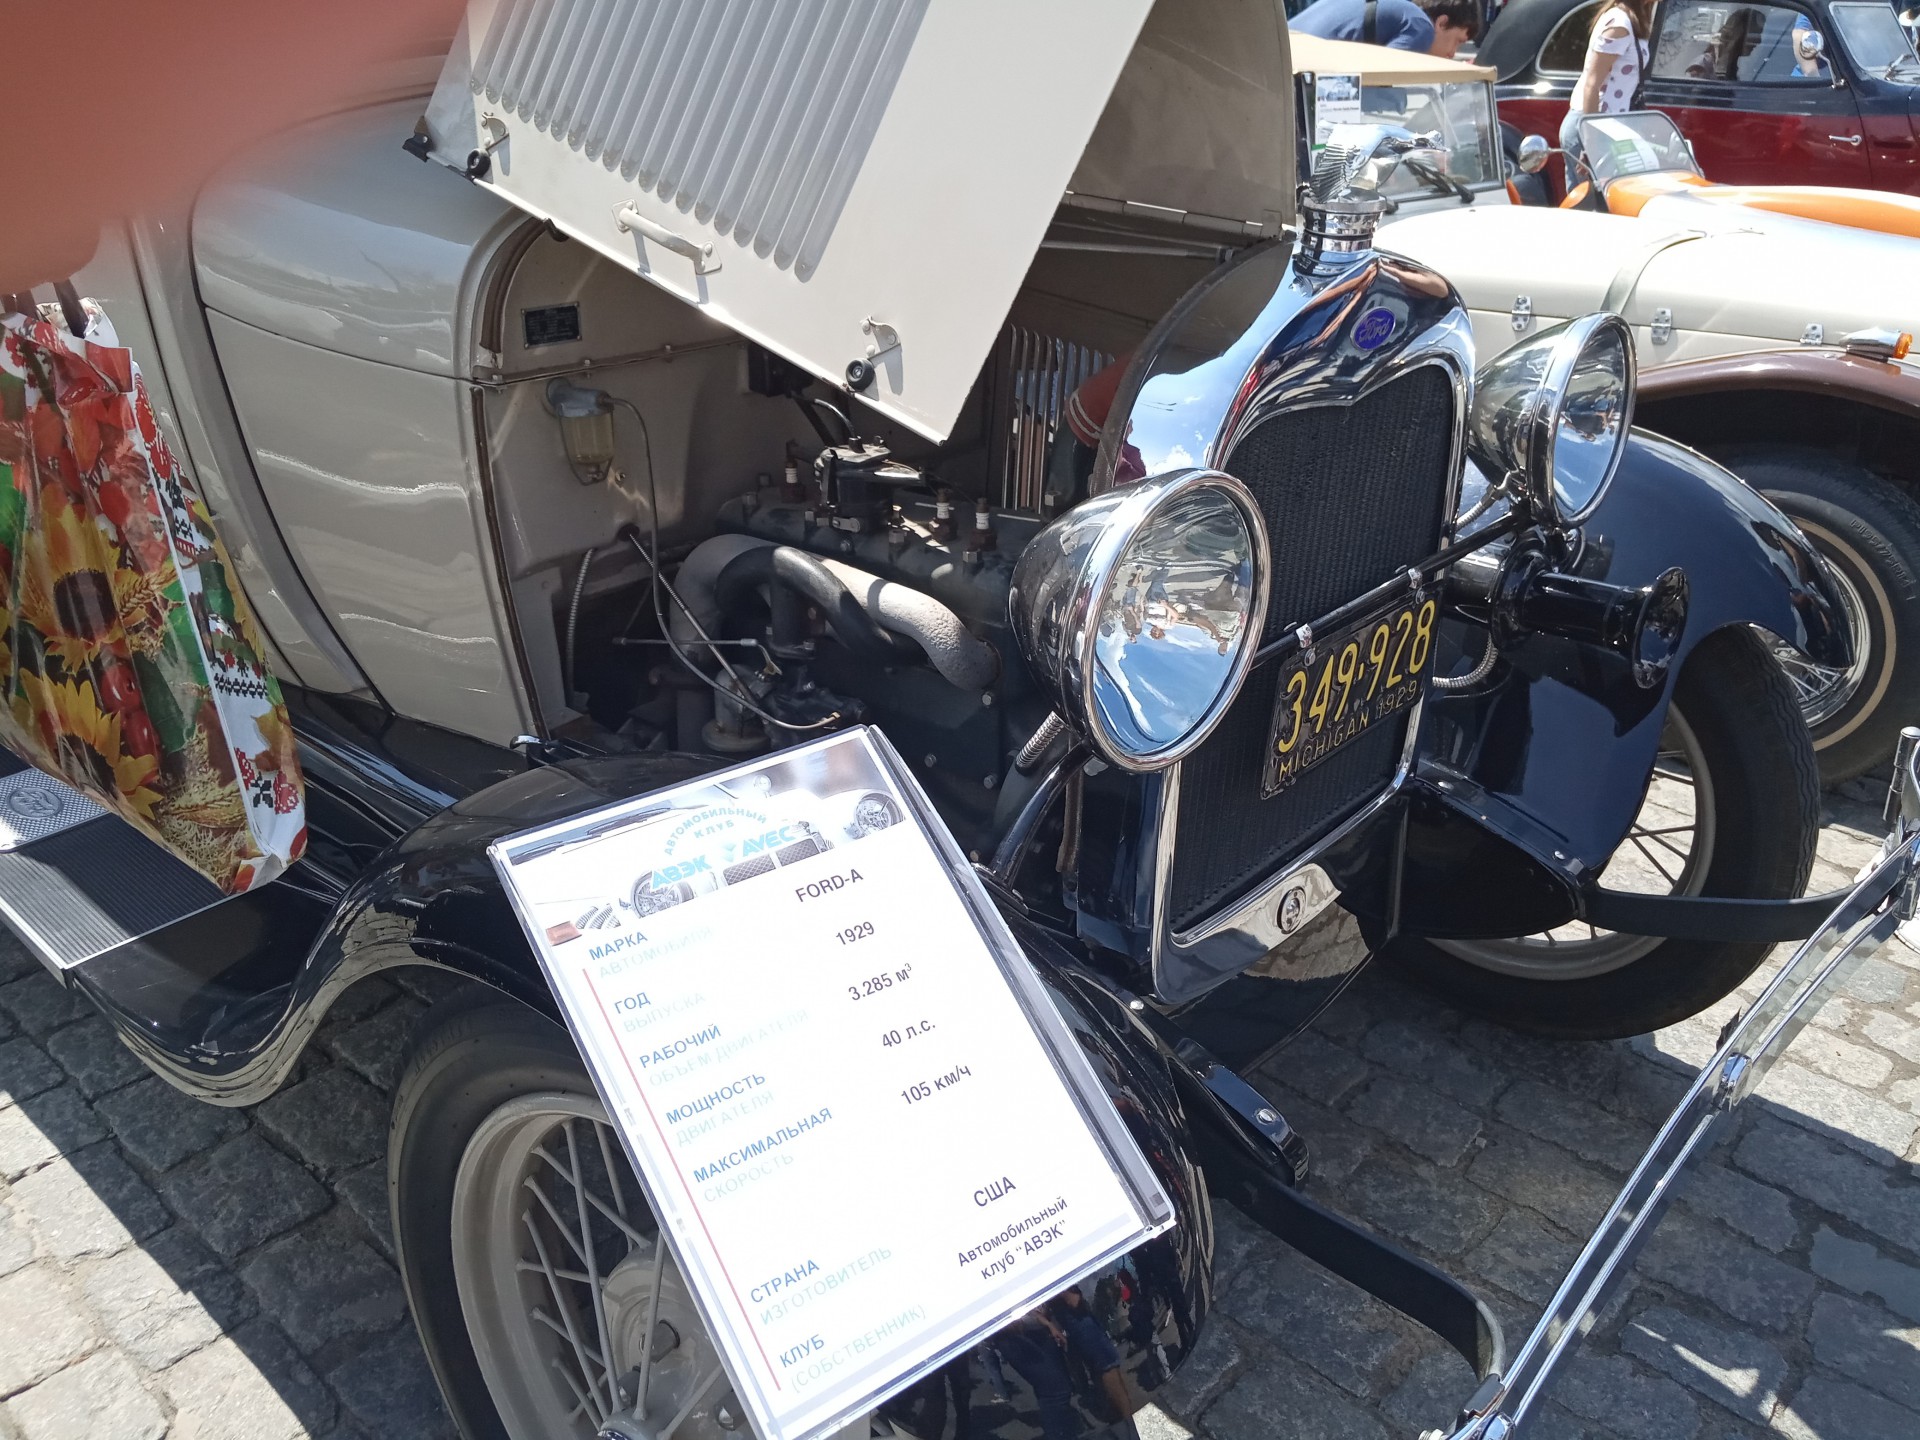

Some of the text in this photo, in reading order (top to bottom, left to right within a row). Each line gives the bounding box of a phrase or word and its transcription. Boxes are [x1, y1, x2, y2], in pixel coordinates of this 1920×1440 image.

[1279, 680, 1418, 782] MICHIGAN 1929
[664, 807, 767, 856] АВТОМОБИЛЬНЫЙ
[693, 819, 734, 839] КЛУБ
[742, 825, 797, 857] AVEC
[651, 854, 713, 889] АВЭК
[795, 868, 864, 903] FORD-A
[588, 931, 648, 961] МАРКА
[599, 926, 713, 979] АВТОМОБИЛЯ
[835, 921, 875, 947] 1929
[614, 991, 651, 1014] ГОД
[848, 972, 893, 1001] 3.285
[623, 992, 706, 1033] ВЫПУСКА
[639, 1023, 722, 1069] РАБОЧИЙ
[648, 1009, 810, 1087] ОБЪЕМ ДВИГАТЕЛЯ
[881, 1018, 936, 1049] 40 л.с.
[665, 1072, 766, 1125] МОЩНОСТЬ
[900, 1064, 972, 1105] 105 км/ч
[675, 1090, 775, 1148] ДВИГАТЕЛЯ
[693, 1108, 833, 1183] МАКСИМАЛЬНАЯ
[703, 1152, 795, 1203] СКОРОСТЬ
[973, 1176, 1017, 1208] США
[957, 1196, 1068, 1267] Автомобильный
[750, 1259, 820, 1304] СТРАНА
[760, 1244, 893, 1326] ИЗГОТОВИТЕЛЬ
[980, 1251, 1015, 1280] клуб
[779, 1334, 825, 1368] КЛУБ
[791, 1304, 926, 1394] (СОБСТВЕННИК)
